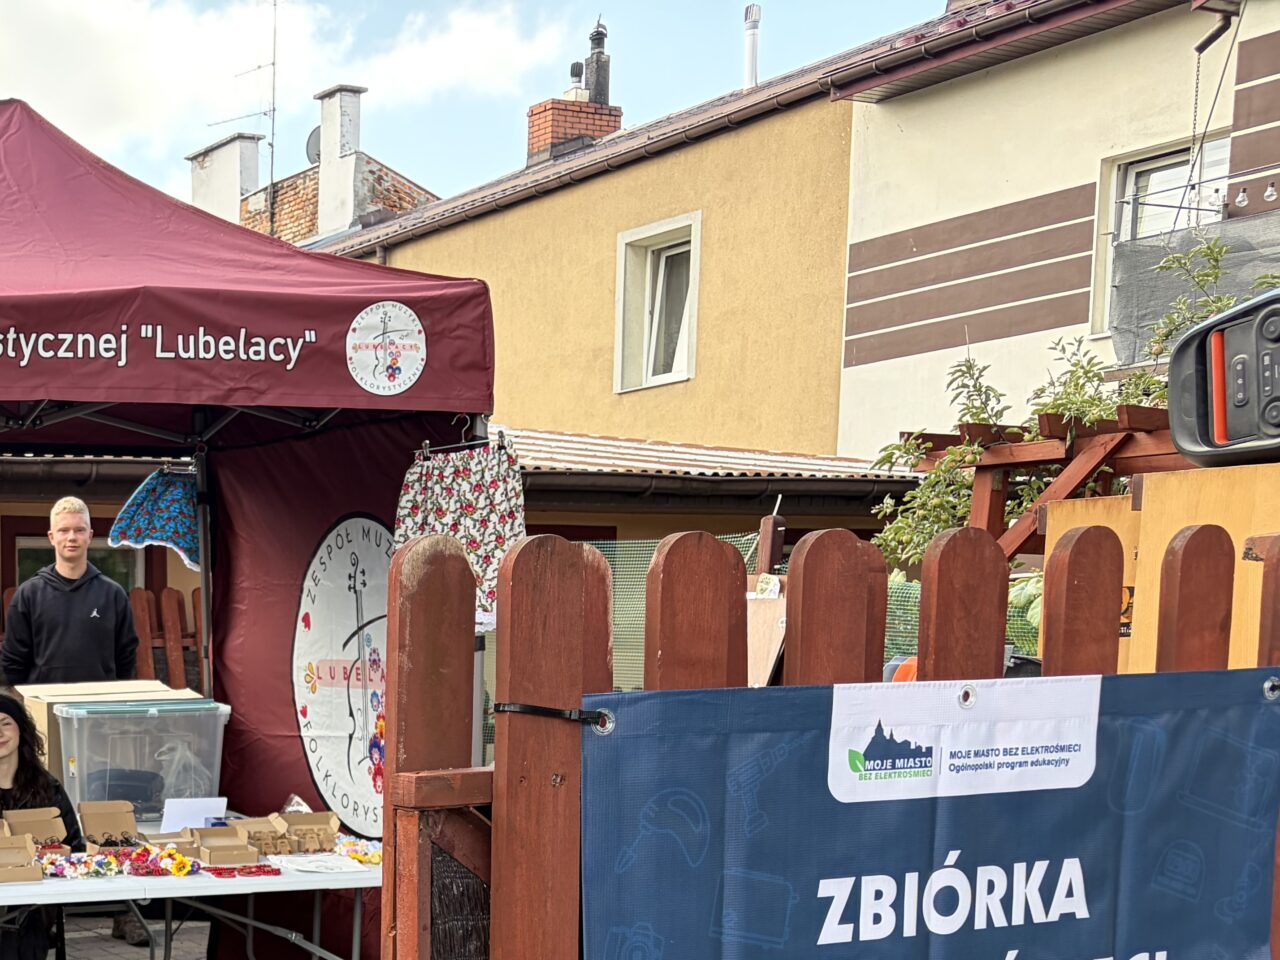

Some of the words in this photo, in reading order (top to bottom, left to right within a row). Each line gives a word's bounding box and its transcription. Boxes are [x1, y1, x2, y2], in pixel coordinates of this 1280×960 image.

[141, 324, 317, 370] "Lubelacy"
[306, 527, 352, 605] ZESPÓŁ
[317, 665, 386, 682] LUBELA
[949, 750, 971, 760] MOJE
[973, 748, 1000, 758] MIASTO
[1003, 747, 1019, 757] BEZ
[1021, 743, 1081, 756] ELEKTROŚMIECI
[865, 759, 893, 771] MOJE
[895, 757, 932, 769] MIASTO
[949, 761, 995, 773] Ogólnopolski
[997, 760, 1028, 771] program
[1030, 757, 1070, 769] edukacyjny
[858, 772, 872, 781] BEZ
[817, 850, 1090, 945] ZBIÓRKA
